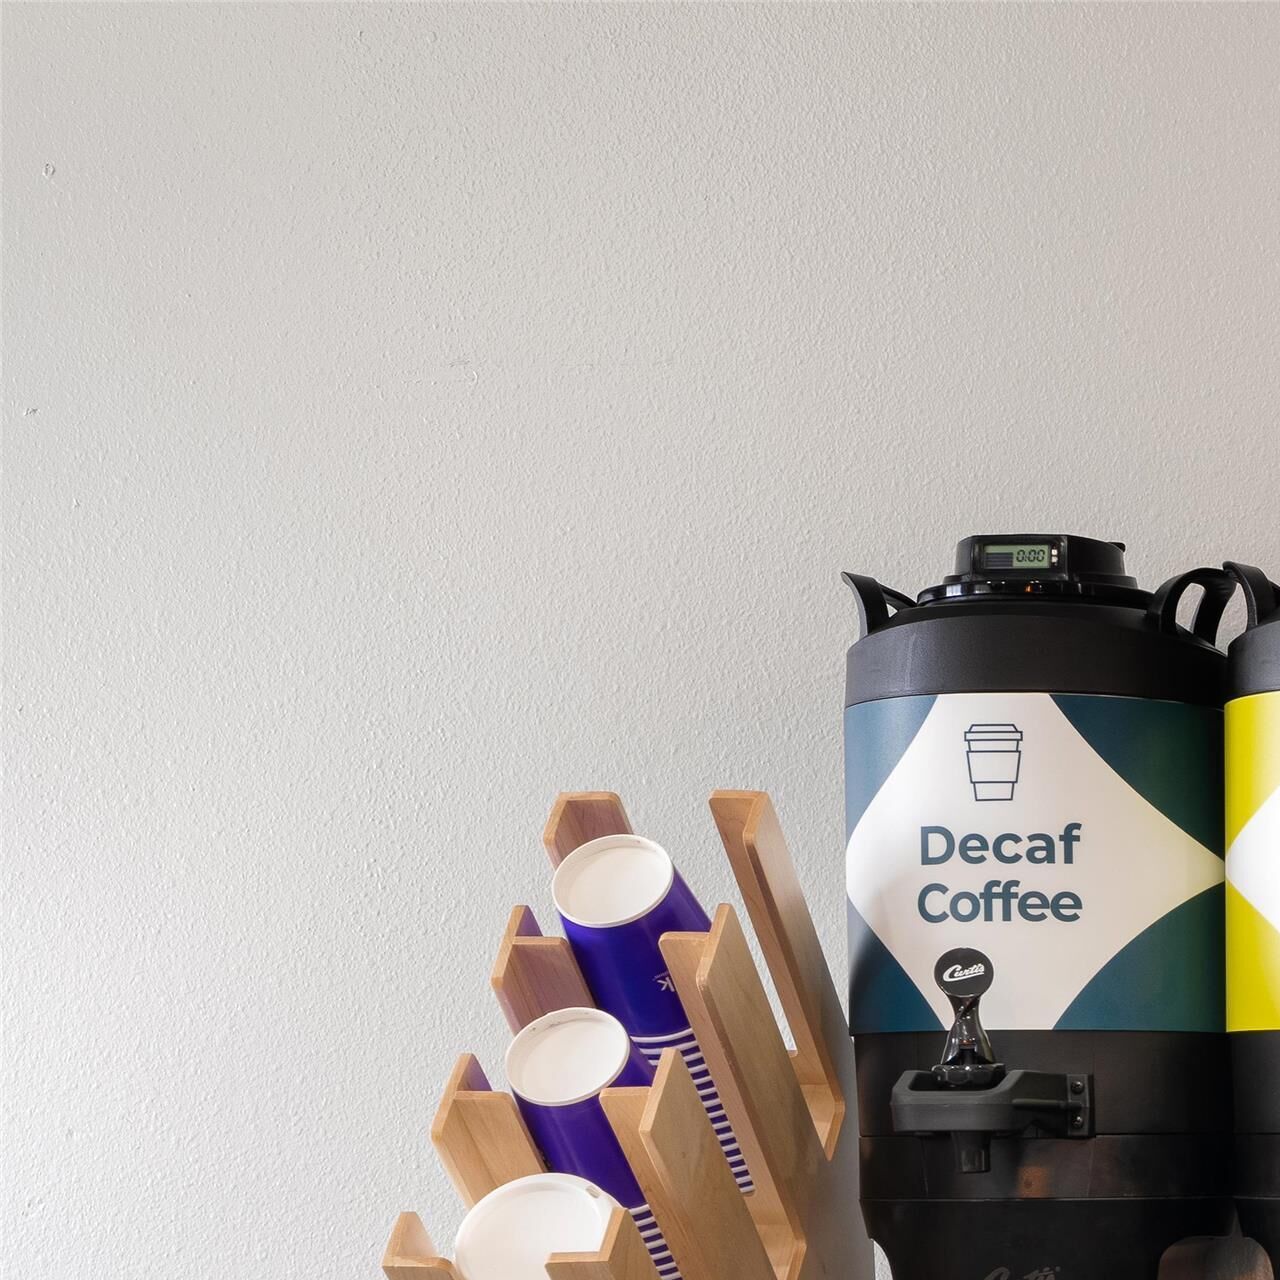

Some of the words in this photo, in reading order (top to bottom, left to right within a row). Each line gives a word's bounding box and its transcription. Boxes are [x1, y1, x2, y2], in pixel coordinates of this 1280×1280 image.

[920, 822, 1081, 864] Decaf
[917, 880, 1083, 923] Coffee
[942, 962, 986, 982] Curtis
